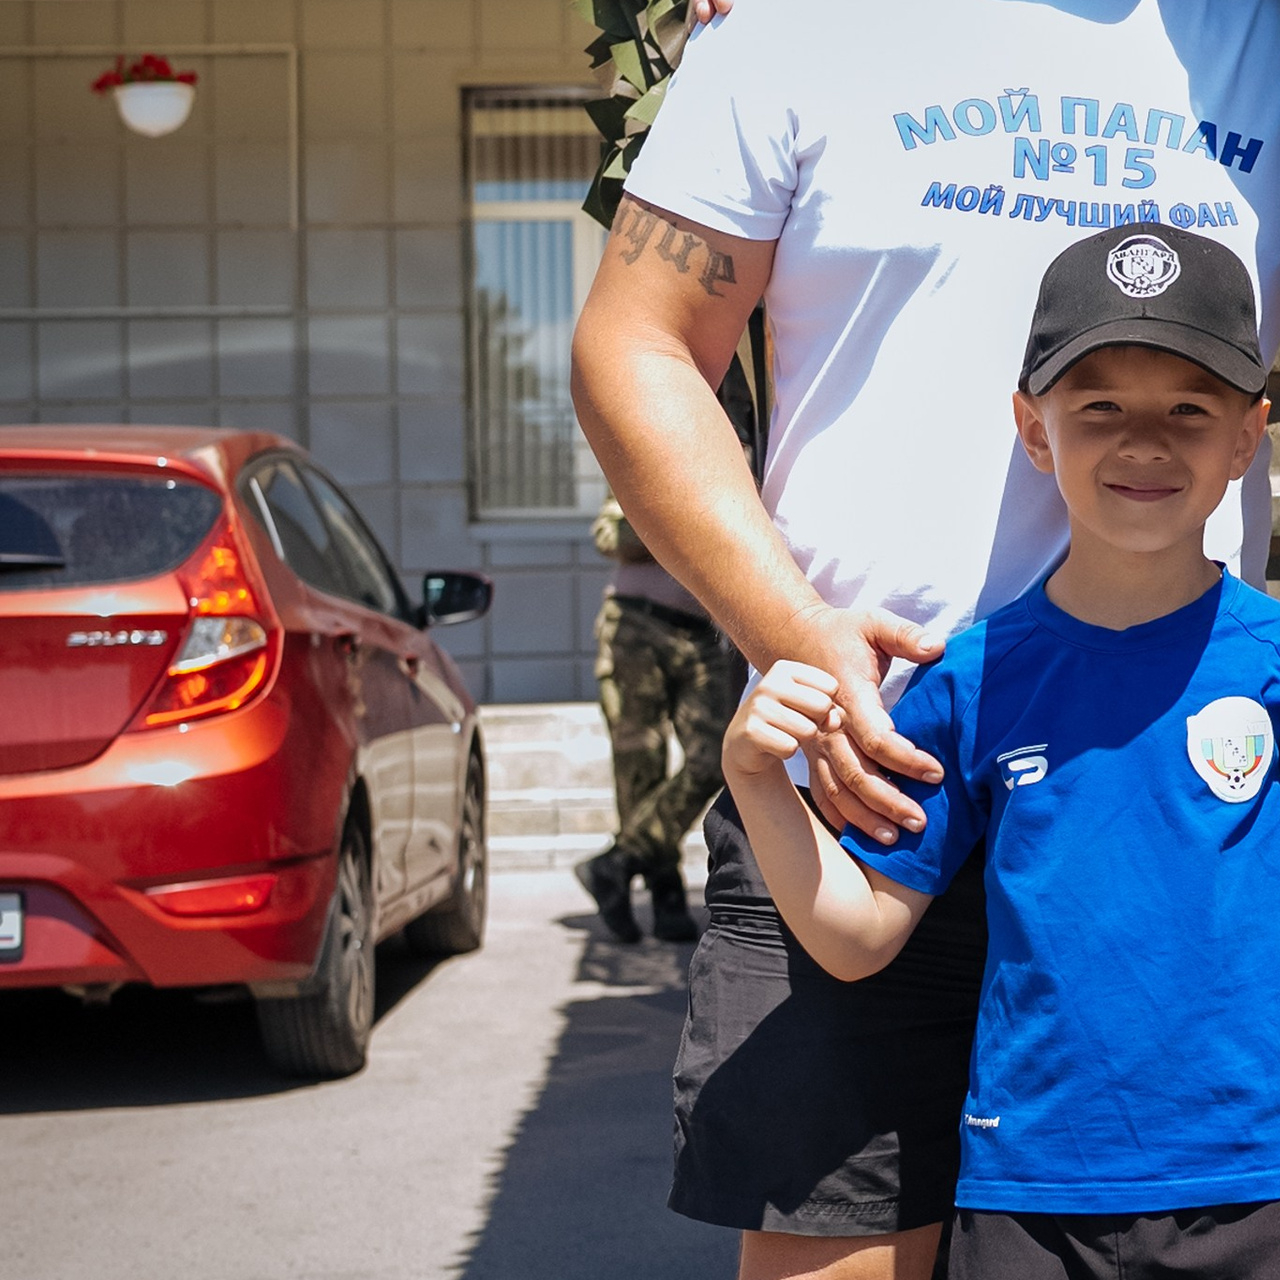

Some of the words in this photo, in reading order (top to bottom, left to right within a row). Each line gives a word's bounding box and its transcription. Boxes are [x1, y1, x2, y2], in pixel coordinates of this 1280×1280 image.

[893, 87, 1042, 150] МОЙ
[1060, 96, 1264, 174] ПАПАН
[1013, 136, 1157, 189] №15
[921, 182, 1006, 215] МОЙ
[1009, 193, 1161, 229] ЛУЧШИЙ
[1169, 201, 1239, 229] ФАН
